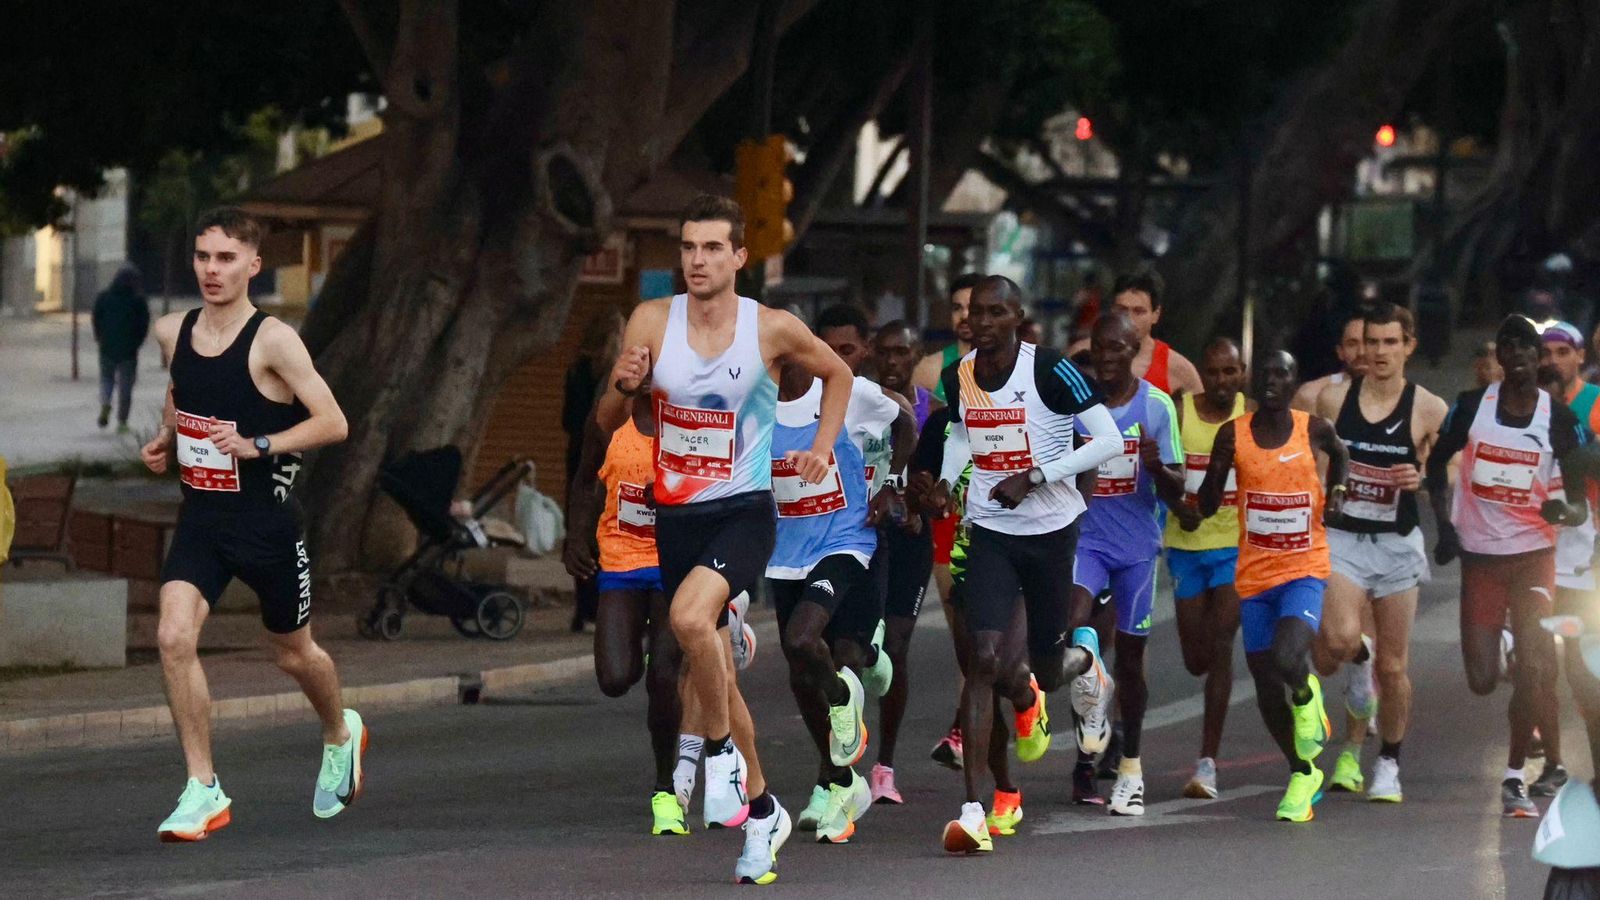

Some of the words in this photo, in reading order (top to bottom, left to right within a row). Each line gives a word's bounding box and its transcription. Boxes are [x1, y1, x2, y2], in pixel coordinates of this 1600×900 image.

[676, 409, 729, 424] GENERALI
[978, 410, 1021, 420] GENERALI
[679, 433, 709, 445] PACER
[985, 434, 1004, 442] KIGEN
[189, 445, 209, 456] PACER
[1349, 481, 1386, 498] 14541
[1263, 496, 1307, 505] GENERALI
[296, 540, 310, 568] 247
[297, 567, 311, 625] TEAM
